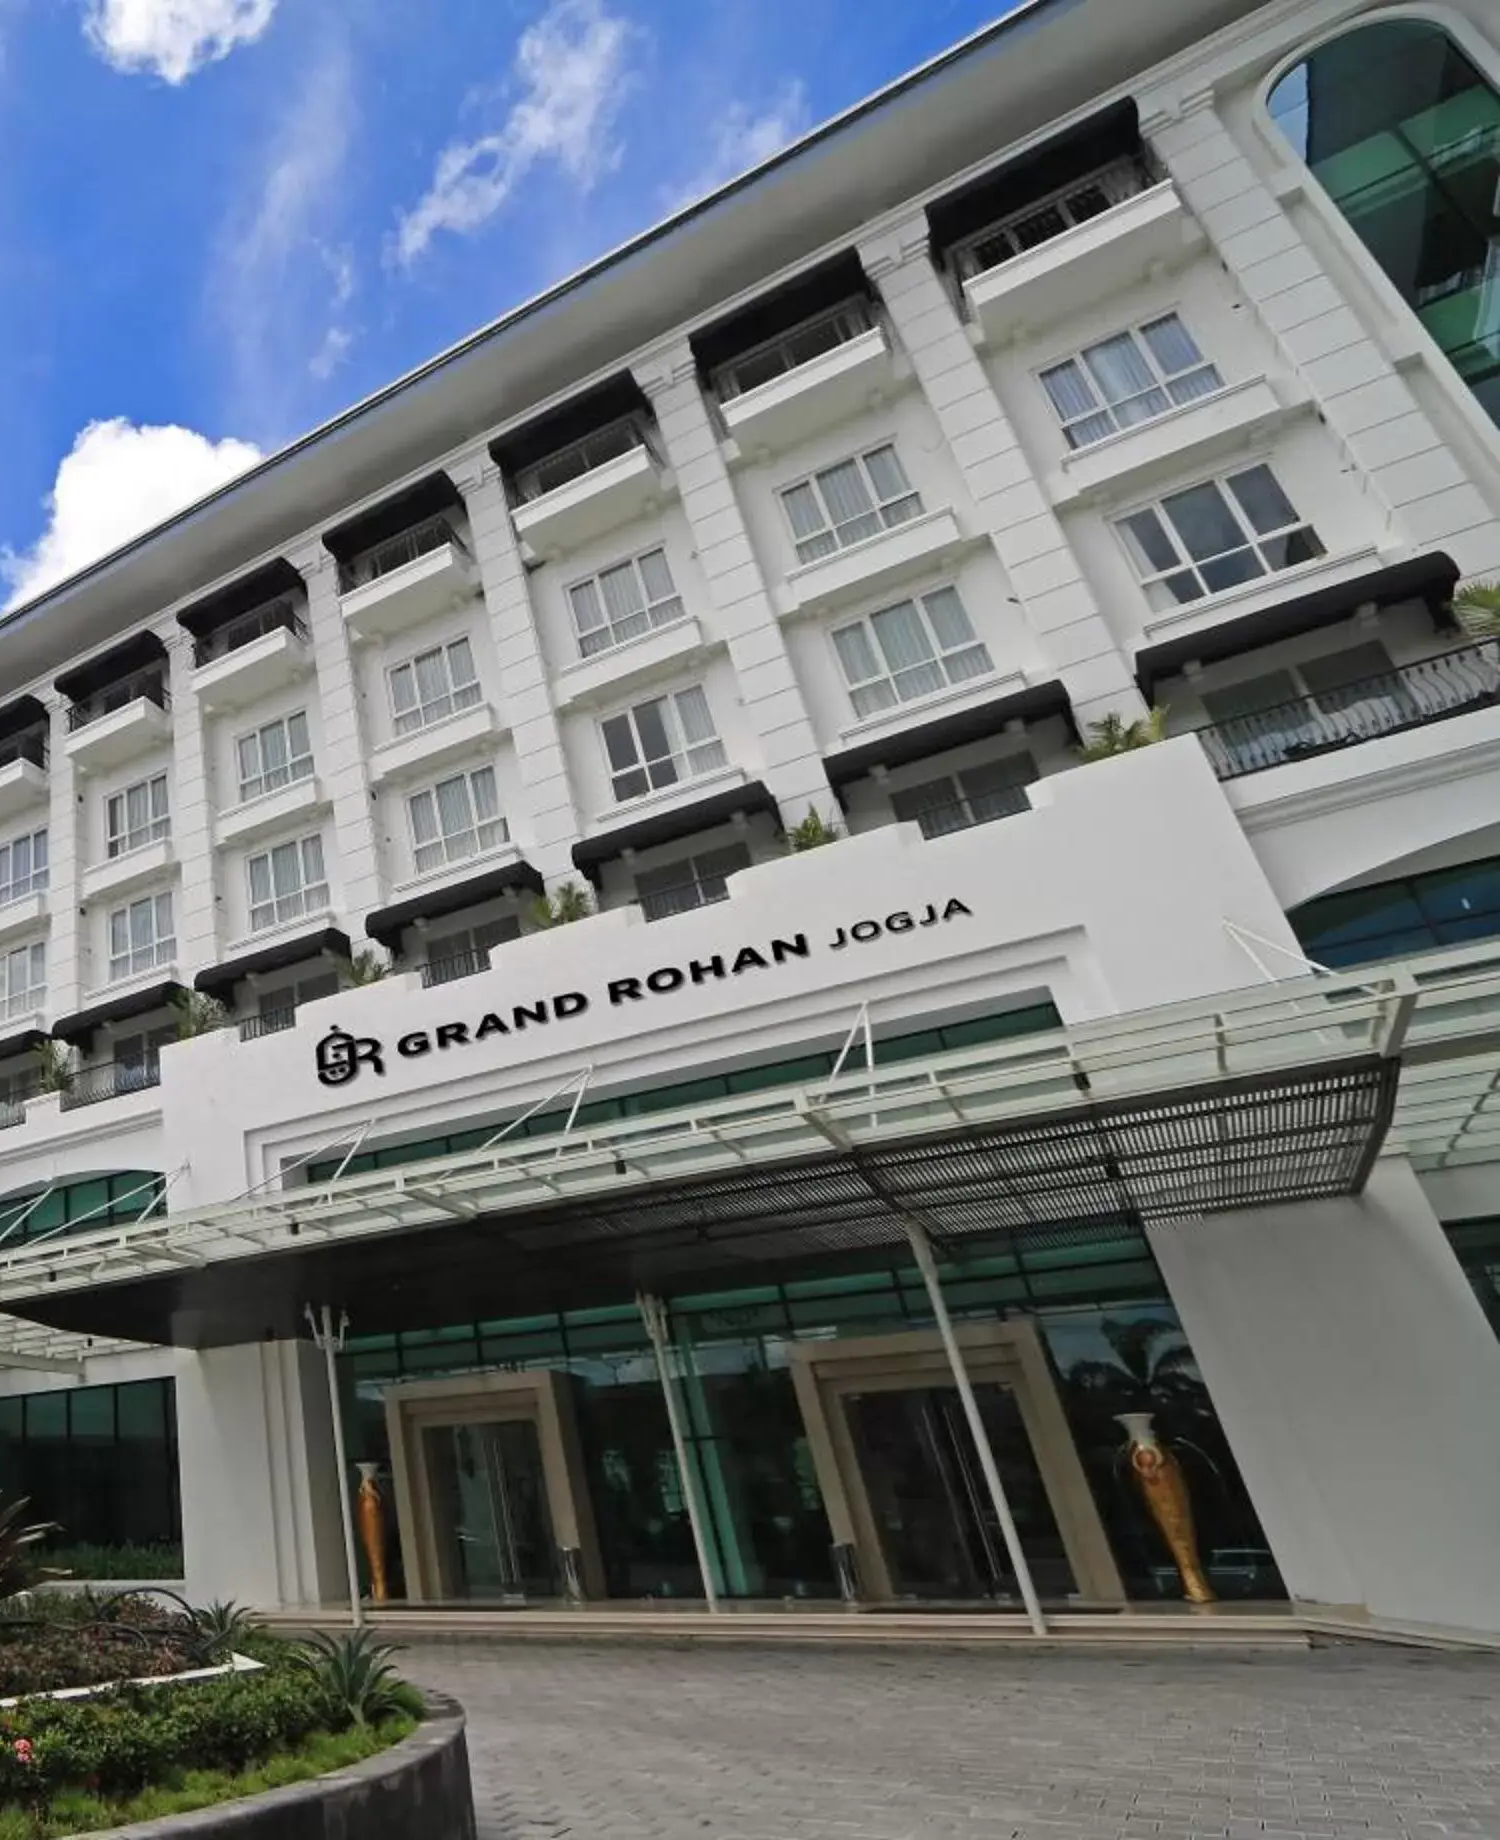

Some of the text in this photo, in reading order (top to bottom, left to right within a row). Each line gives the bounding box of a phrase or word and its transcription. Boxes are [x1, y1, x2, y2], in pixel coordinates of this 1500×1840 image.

[397, 991, 588, 1057] GRAND
[607, 933, 810, 1006] ROHAN
[829, 897, 973, 949] JOGJA
